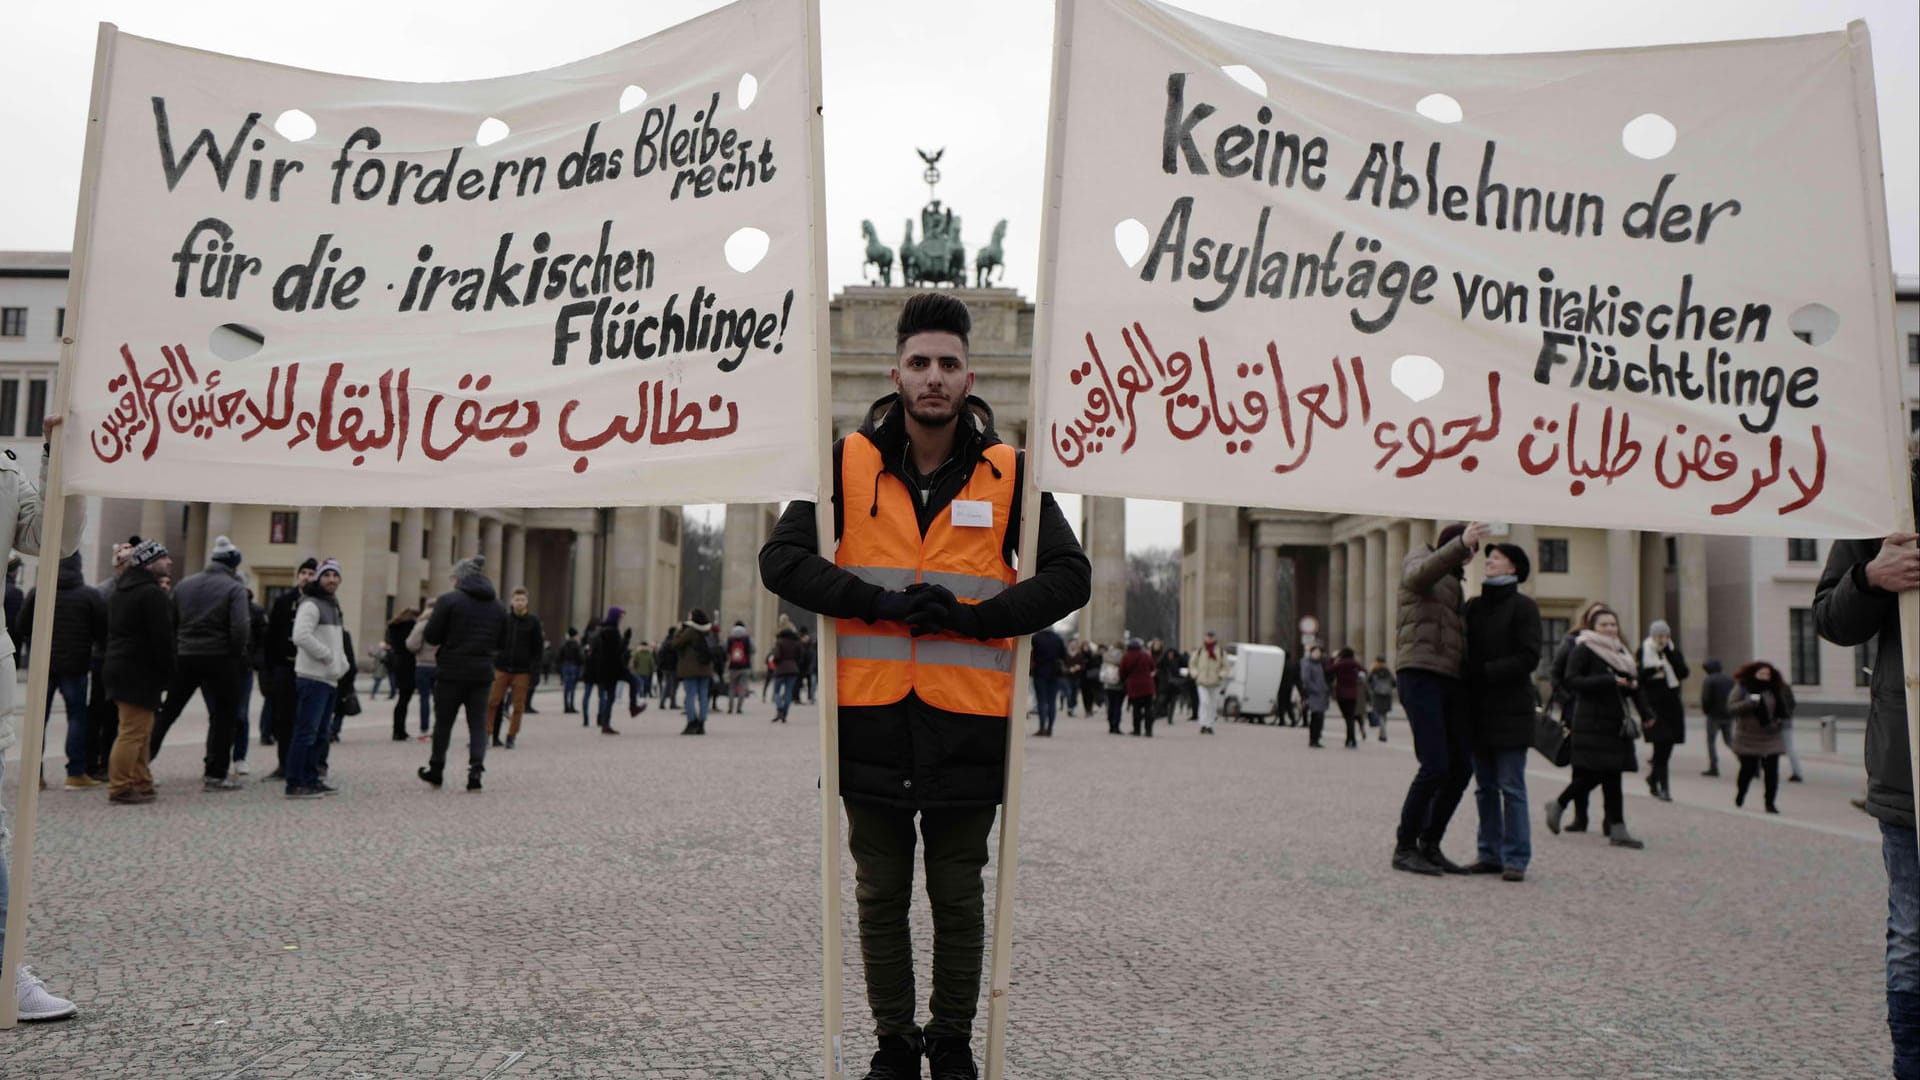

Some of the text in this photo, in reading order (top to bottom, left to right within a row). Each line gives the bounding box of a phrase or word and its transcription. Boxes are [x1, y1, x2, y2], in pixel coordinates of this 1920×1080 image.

[152, 96, 304, 201] Wir
[331, 126, 547, 205] fordern
[557, 121, 624, 190] das
[670, 137, 777, 200] recht
[1345, 140, 1604, 236] Ablehnun
[1622, 173, 1742, 244] der
[172, 217, 655, 312] für die irakischen
[1140, 196, 1772, 343] Asylantäge von irakischen
[91, 343, 739, 473] نطالب بحق البقاء للاجئين العراقيين
[1165, 337, 1371, 474] العراقيات
[1374, 371, 1502, 479] لجوء
[1533, 330, 1820, 434] Flüchtlinge
[1517, 402, 1642, 497] طلبات
